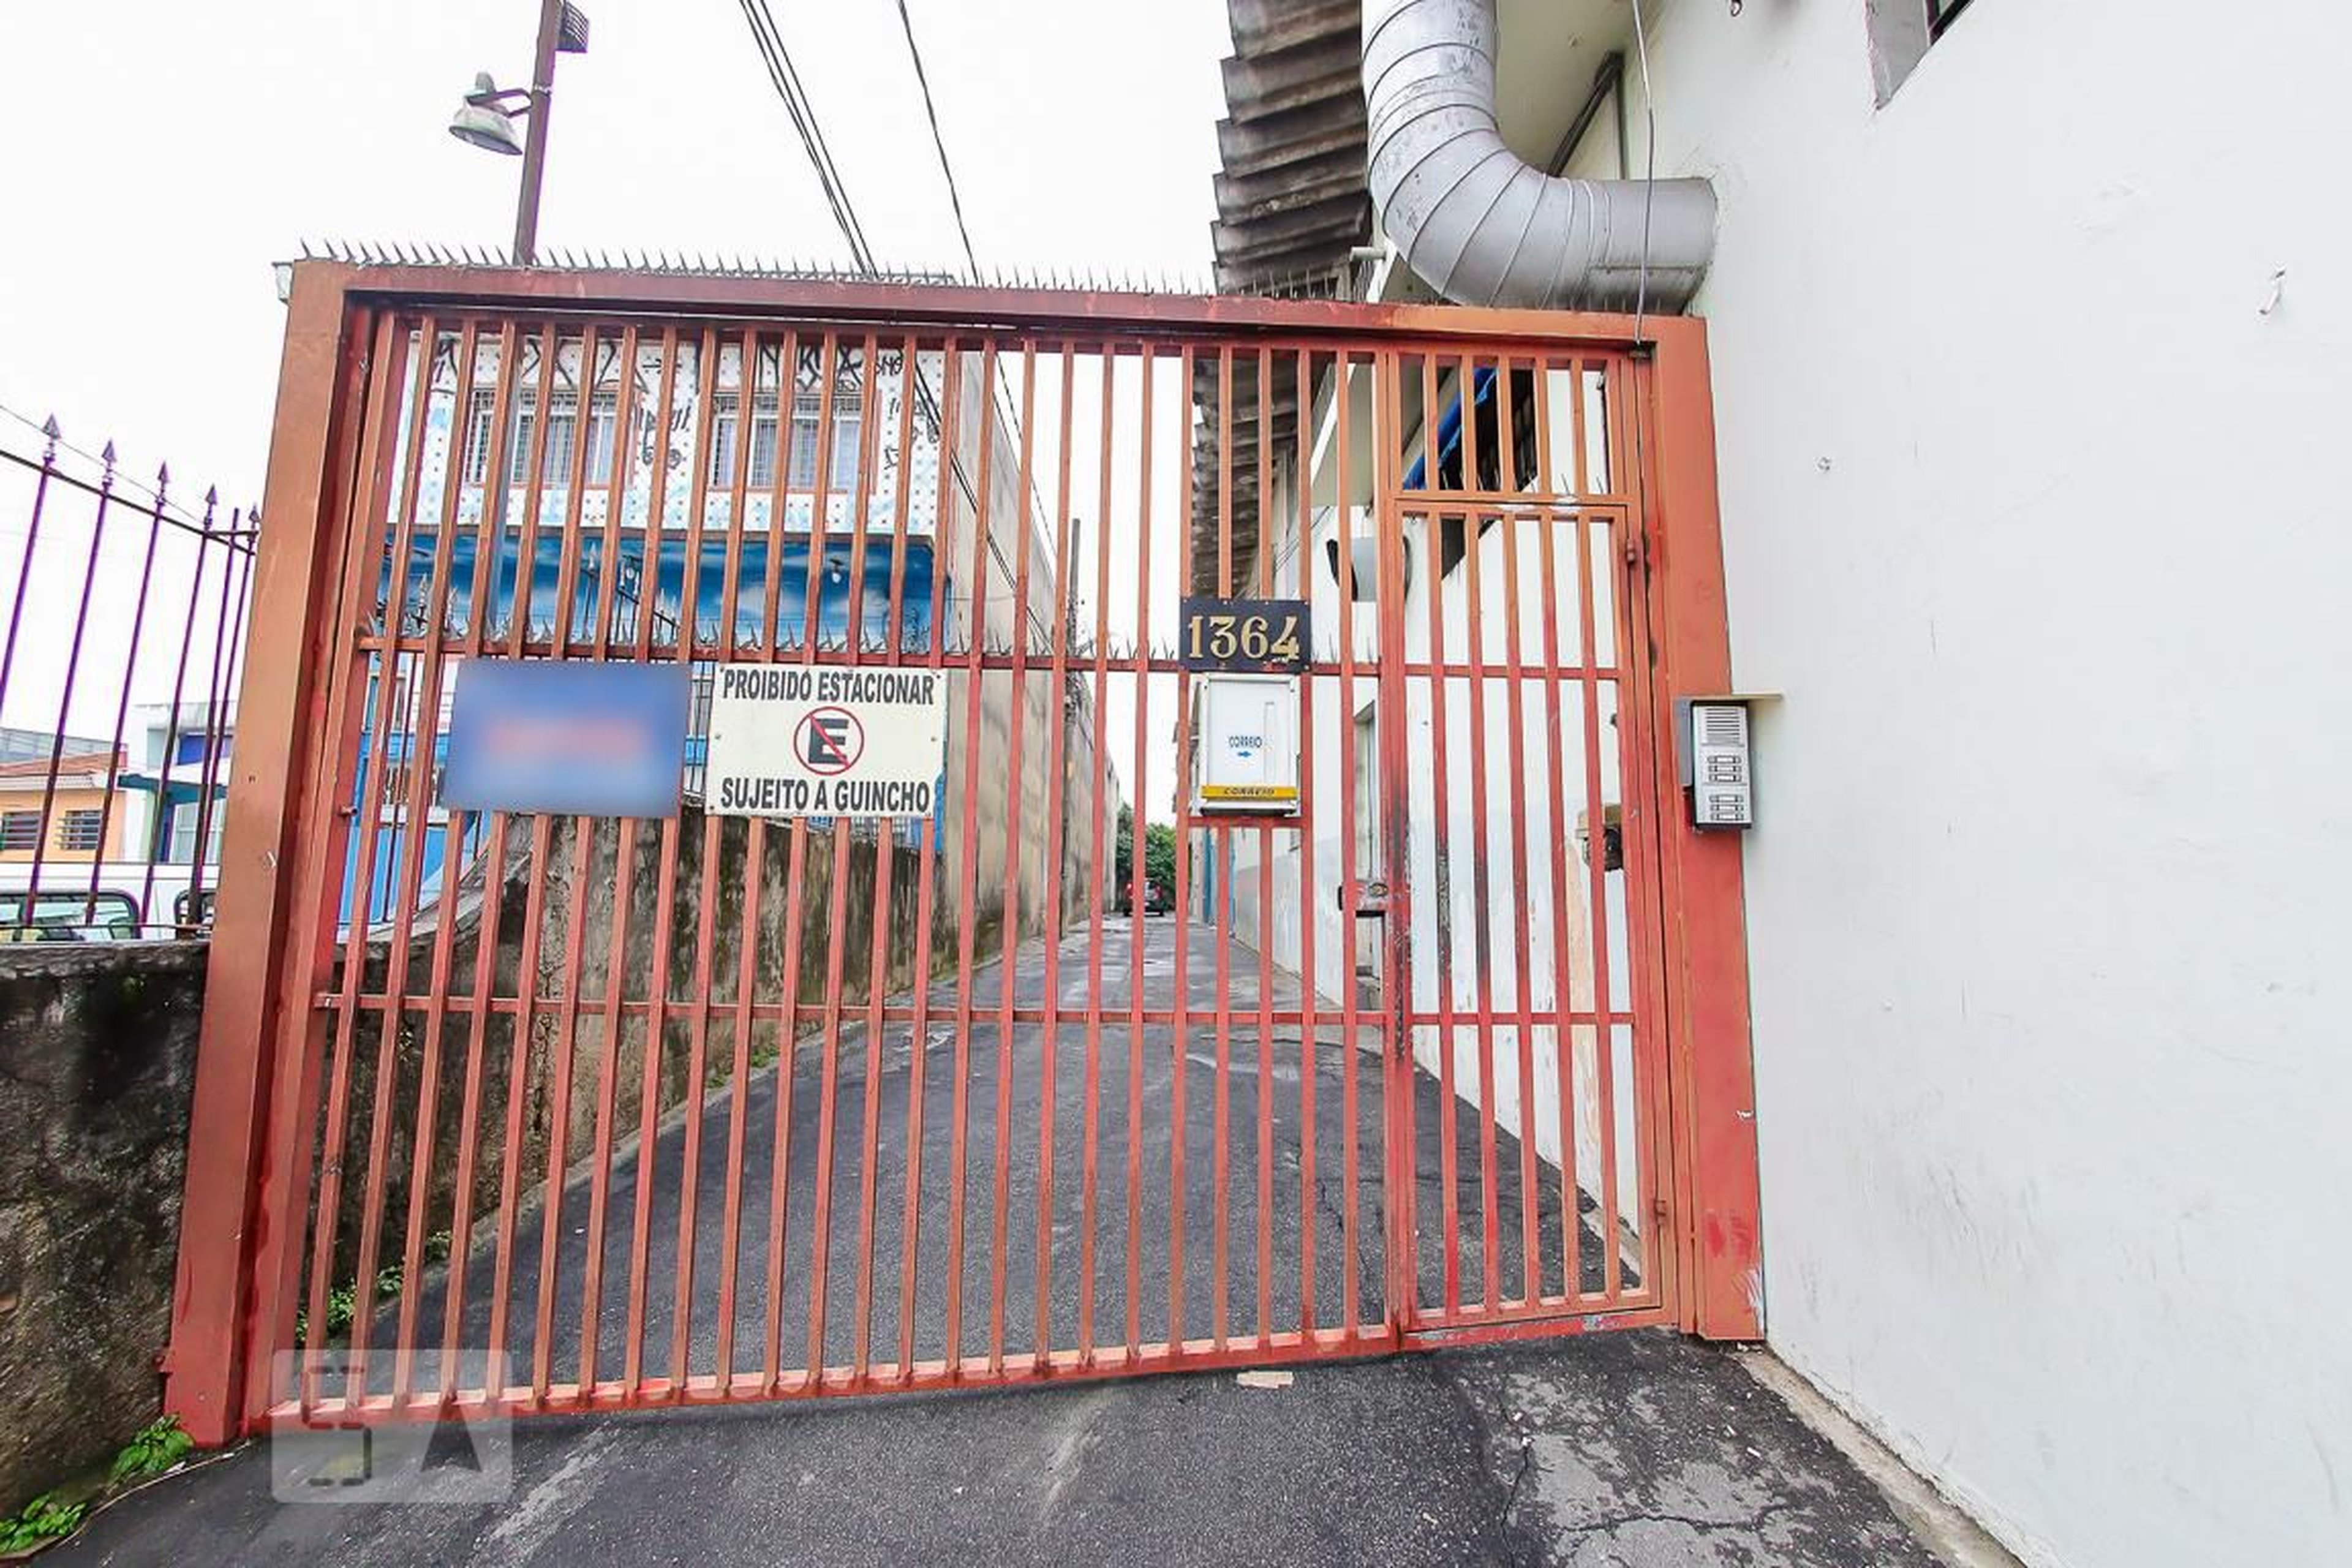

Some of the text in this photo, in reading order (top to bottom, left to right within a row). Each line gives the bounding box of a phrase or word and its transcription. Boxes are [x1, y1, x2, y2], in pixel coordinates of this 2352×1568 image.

[1188, 616, 1300, 660] 1364
[722, 669, 933, 704] PROIBIDO ESTACIONAR
[1228, 736, 1263, 748] CORREIO
[721, 777, 930, 812] SUJEITO A GUINCHO
[1223, 787, 1275, 796] CORREIO
